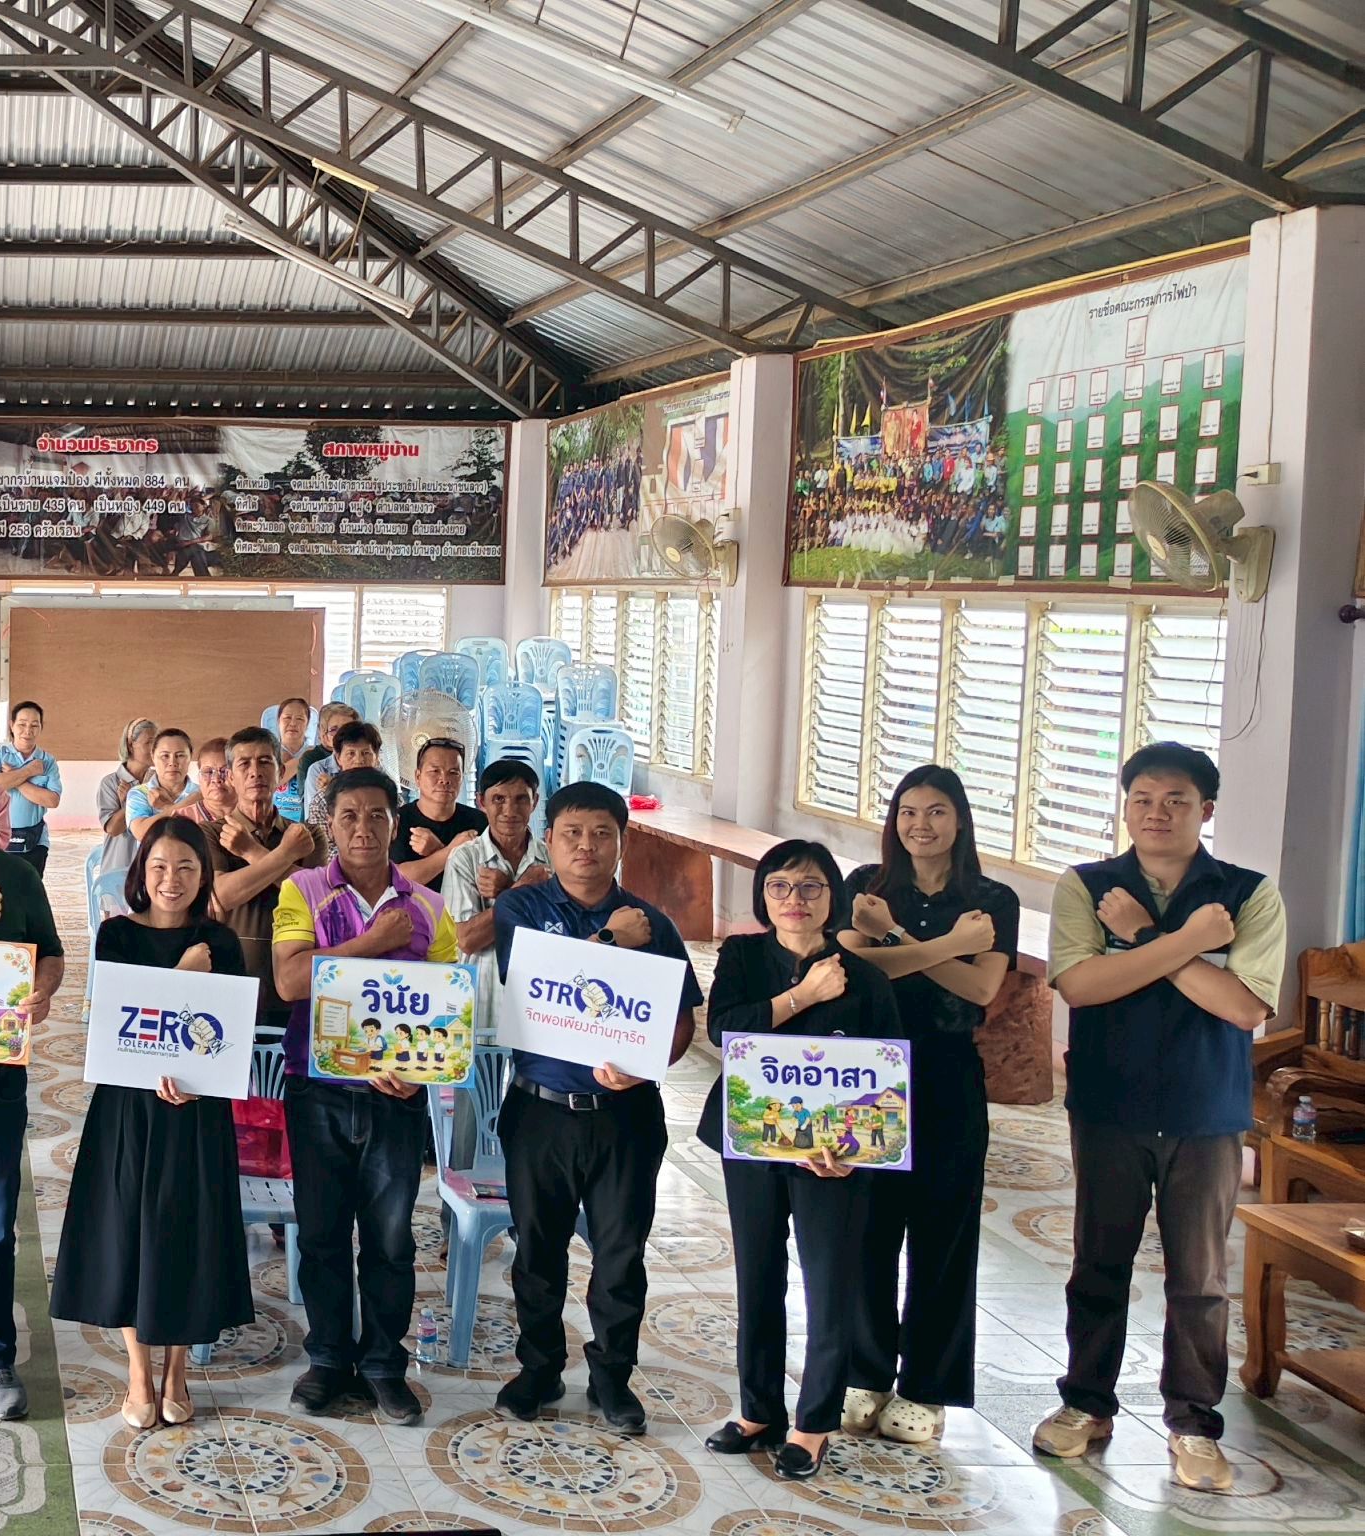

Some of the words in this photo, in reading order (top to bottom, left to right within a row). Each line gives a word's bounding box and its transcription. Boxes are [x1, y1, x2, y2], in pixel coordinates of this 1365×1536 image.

[37, 435, 158, 453] จำนวนประชากร
[322, 441, 419, 461] สภาพหมู่บ้าน
[94, 467, 140, 487] มีทั้งหมด
[144, 475, 165, 487] 884
[174, 476, 190, 487] คน
[236, 475, 270, 490] ทิศเหนือ
[43, 500, 65, 513] 435
[68, 500, 85, 513] คน
[94, 495, 140, 517] เป็นหญิง
[143, 500, 165, 513] 449
[168, 500, 186, 513] คน
[235, 495, 259, 511] ทิศใต้
[349, 498, 364, 517] หมู่
[364, 501, 372, 513] 4
[9, 524, 30, 537] 258
[34, 520, 82, 537] ครัวเรือน
[235, 517, 285, 532] ทิศตะวันออก
[234, 538, 280, 554] ทิศตะวันตก
[360, 978, 430, 1018] วินัย
[528, 977, 652, 1022] STRONG
[118, 1005, 224, 1055] ZERO
[525, 1007, 646, 1045] จิตพอเพียงต้านทุจริต
[118, 1038, 180, 1053] TOLERANCE
[760, 1056, 877, 1090] จิตอาสา
